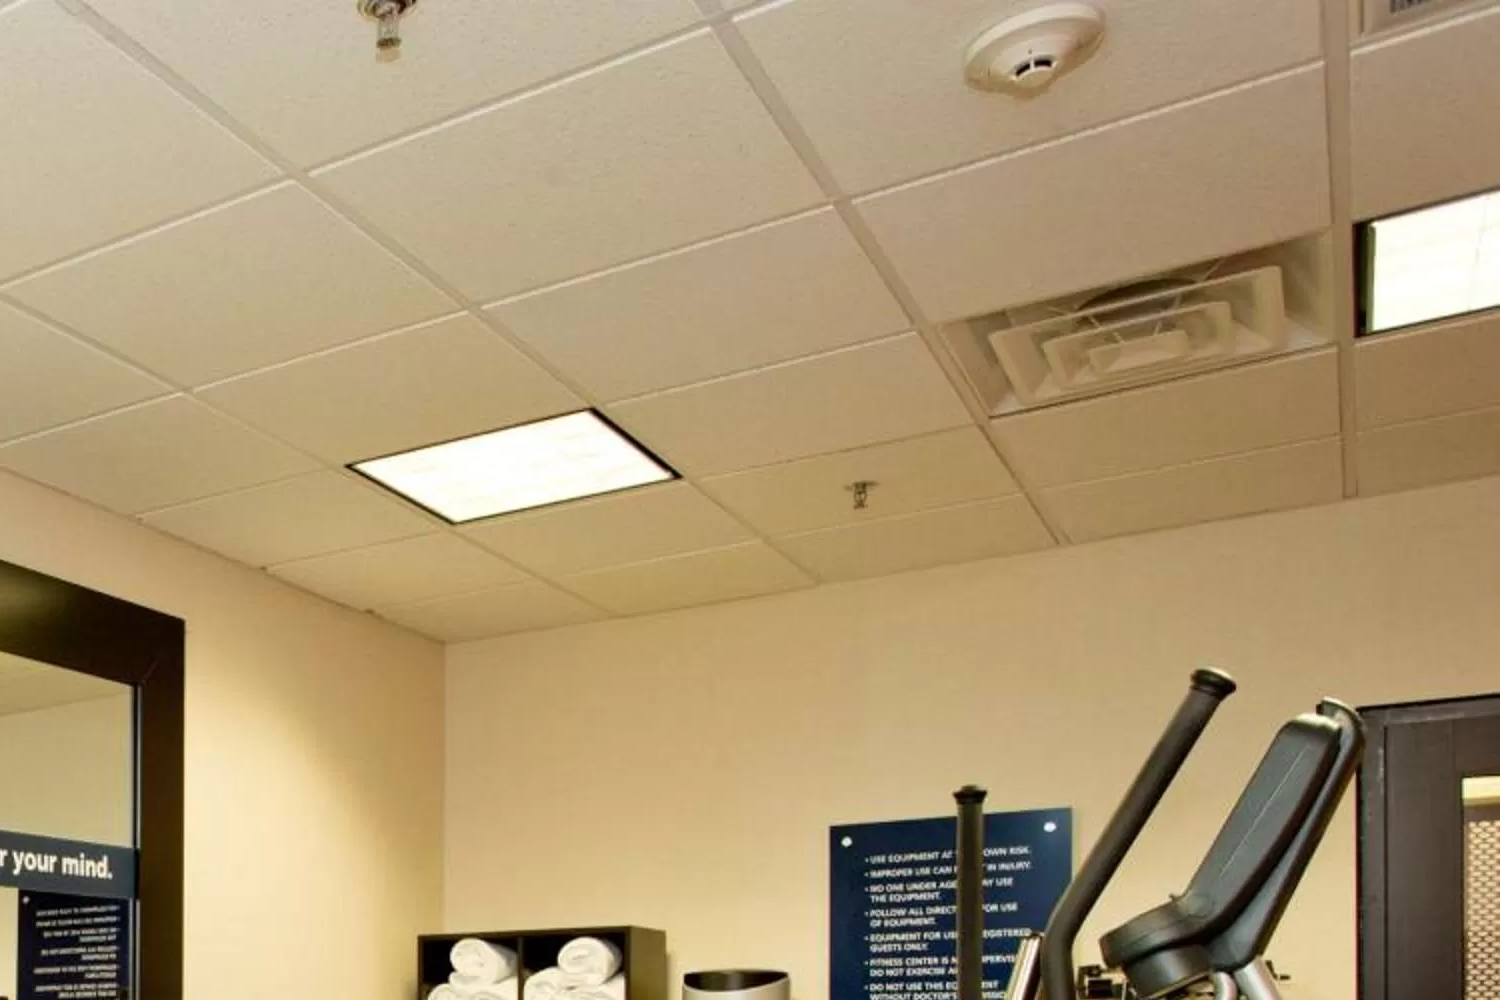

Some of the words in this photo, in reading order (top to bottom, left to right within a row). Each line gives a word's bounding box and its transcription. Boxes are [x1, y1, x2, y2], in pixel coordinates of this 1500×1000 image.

[887, 851, 940, 863] EQUIPMENT
[982, 848, 1007, 857] OWN
[12, 851, 58, 876] your
[61, 852, 113, 880] mind.
[870, 867, 913, 878] IMPROPER
[933, 865, 953, 875] CAN
[886, 883, 904, 892] ONE
[905, 881, 937, 891] UNDER
[870, 894, 887, 903] THE
[870, 907, 907, 917] FOLLOW
[908, 906, 923, 916] ALL
[870, 932, 921, 942] EQUIPMENT
[923, 931, 941, 940] FOR
[982, 927, 1032, 938] EGISTERED
[870, 957, 903, 966] FITNESS
[905, 956, 939, 966] CENTER
[870, 968, 885, 977] DO
[886, 967, 904, 976] NOT
[870, 983, 884, 992] DO
[886, 982, 904, 991] NOT
[905, 982, 922, 991] USE
[924, 981, 944, 991] THIS
[870, 992, 910, 1000] WITHOUT
